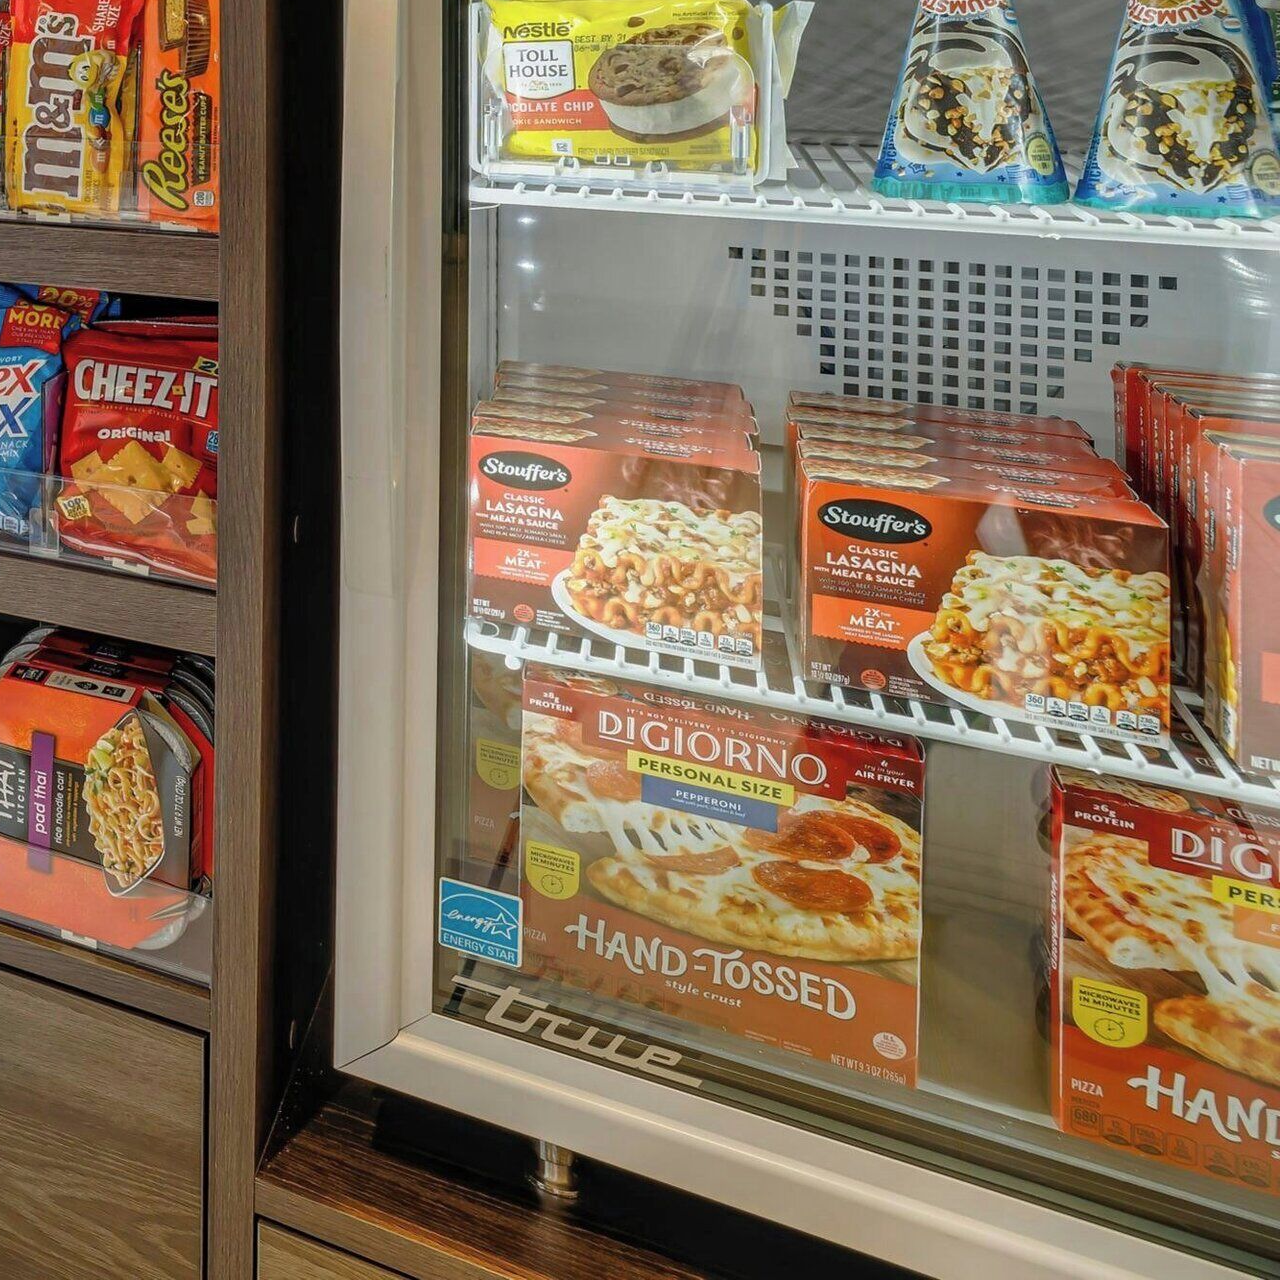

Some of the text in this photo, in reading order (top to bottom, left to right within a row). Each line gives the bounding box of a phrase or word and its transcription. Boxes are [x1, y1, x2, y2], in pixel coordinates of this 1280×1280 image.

[106, 2, 121, 29] SIZE
[517, 48, 559, 62] TOLL
[509, 65, 568, 77] HOUSE
[564, 102, 594, 112] CHIP
[143, 71, 189, 210] Reese's
[8, 310, 65, 329] MORE
[483, 457, 568, 482] Stouffer's
[503, 493, 545, 504] CLASSIC
[485, 500, 564, 521] LASAGNA
[823, 506, 927, 535] Stouffer's
[490, 514, 559, 530] MEAT SAUCE
[848, 545, 899, 559] CLASSIC
[505, 556, 543, 569] MEAT
[826, 552, 922, 578] LASAGNA
[831, 568, 915, 587] MEAT SAUCE
[864, 607, 880, 618] 2X
[849, 616, 895, 631] MEAT
[529, 698, 573, 714] PROTEIN
[638, 757, 782, 800] PERSONAL SIZE
[854, 769, 915, 789] AIR FRYER
[17, 769, 26, 824] KITCHEN
[34, 770, 48, 835] pad thai
[675, 789, 742, 811] PEPPERONI
[54, 793, 64, 826] noodle
[1074, 810, 1136, 831] PROTEIN
[540, 859, 574, 872] MINUTES
[443, 933, 515, 961] ENERGY STAR
[563, 912, 858, 1022] HAND-TOSSED
[665, 978, 742, 1009] style crust
[1078, 989, 1141, 1008] MICROWAVES
[1092, 999, 1140, 1016] MINUTES
[1070, 1078, 1104, 1098] PIZZA
